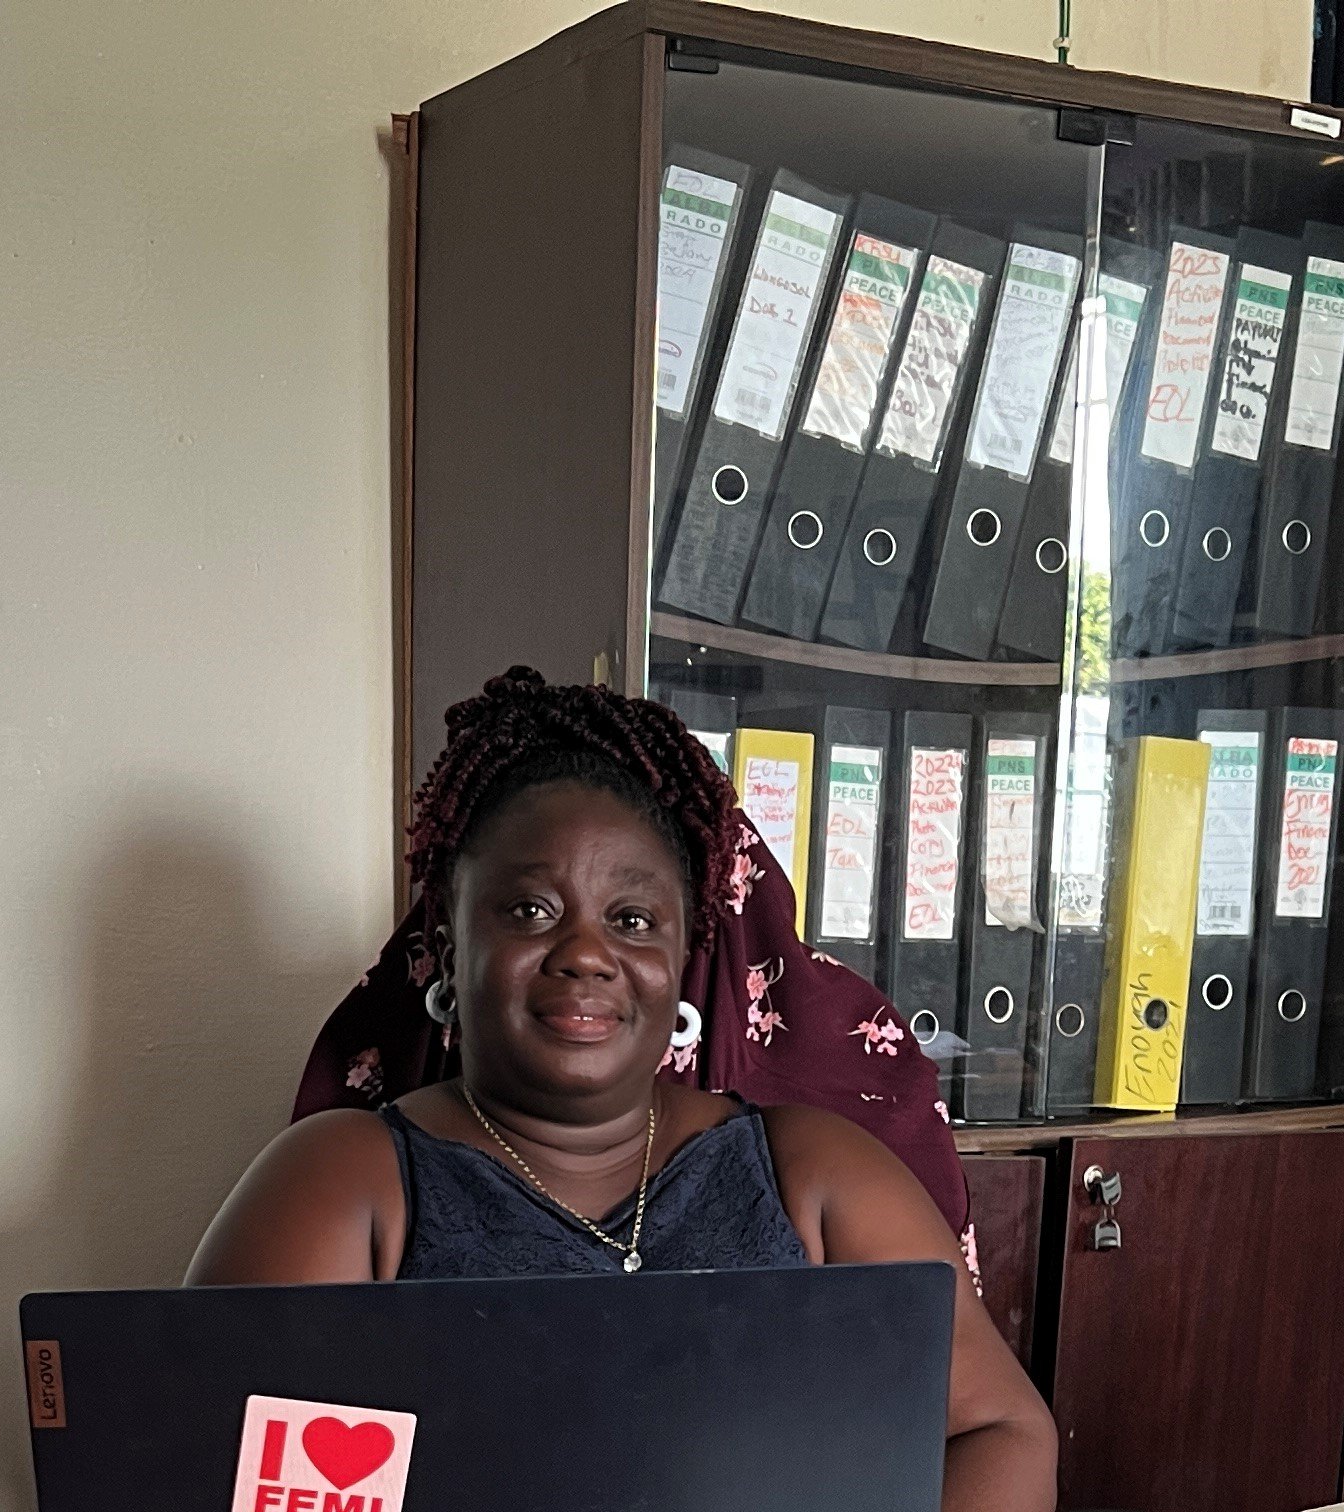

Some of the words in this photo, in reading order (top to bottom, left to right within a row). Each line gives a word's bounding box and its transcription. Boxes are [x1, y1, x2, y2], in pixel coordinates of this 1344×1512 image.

[666, 210, 722, 234] RADO
[767, 235, 821, 262] RADO
[848, 276, 898, 303] PEACE
[1009, 284, 1063, 306] RADO
[1248, 289, 1277, 303] PNS
[1238, 303, 1283, 324] PEACE
[997, 759, 1026, 773] PNS
[990, 779, 1031, 792] PEACE
[1290, 776, 1330, 788] PEACE
[832, 786, 874, 801] PEACE
[39, 1348, 58, 1420] Lenovo
[259, 1419, 288, 1482] I
